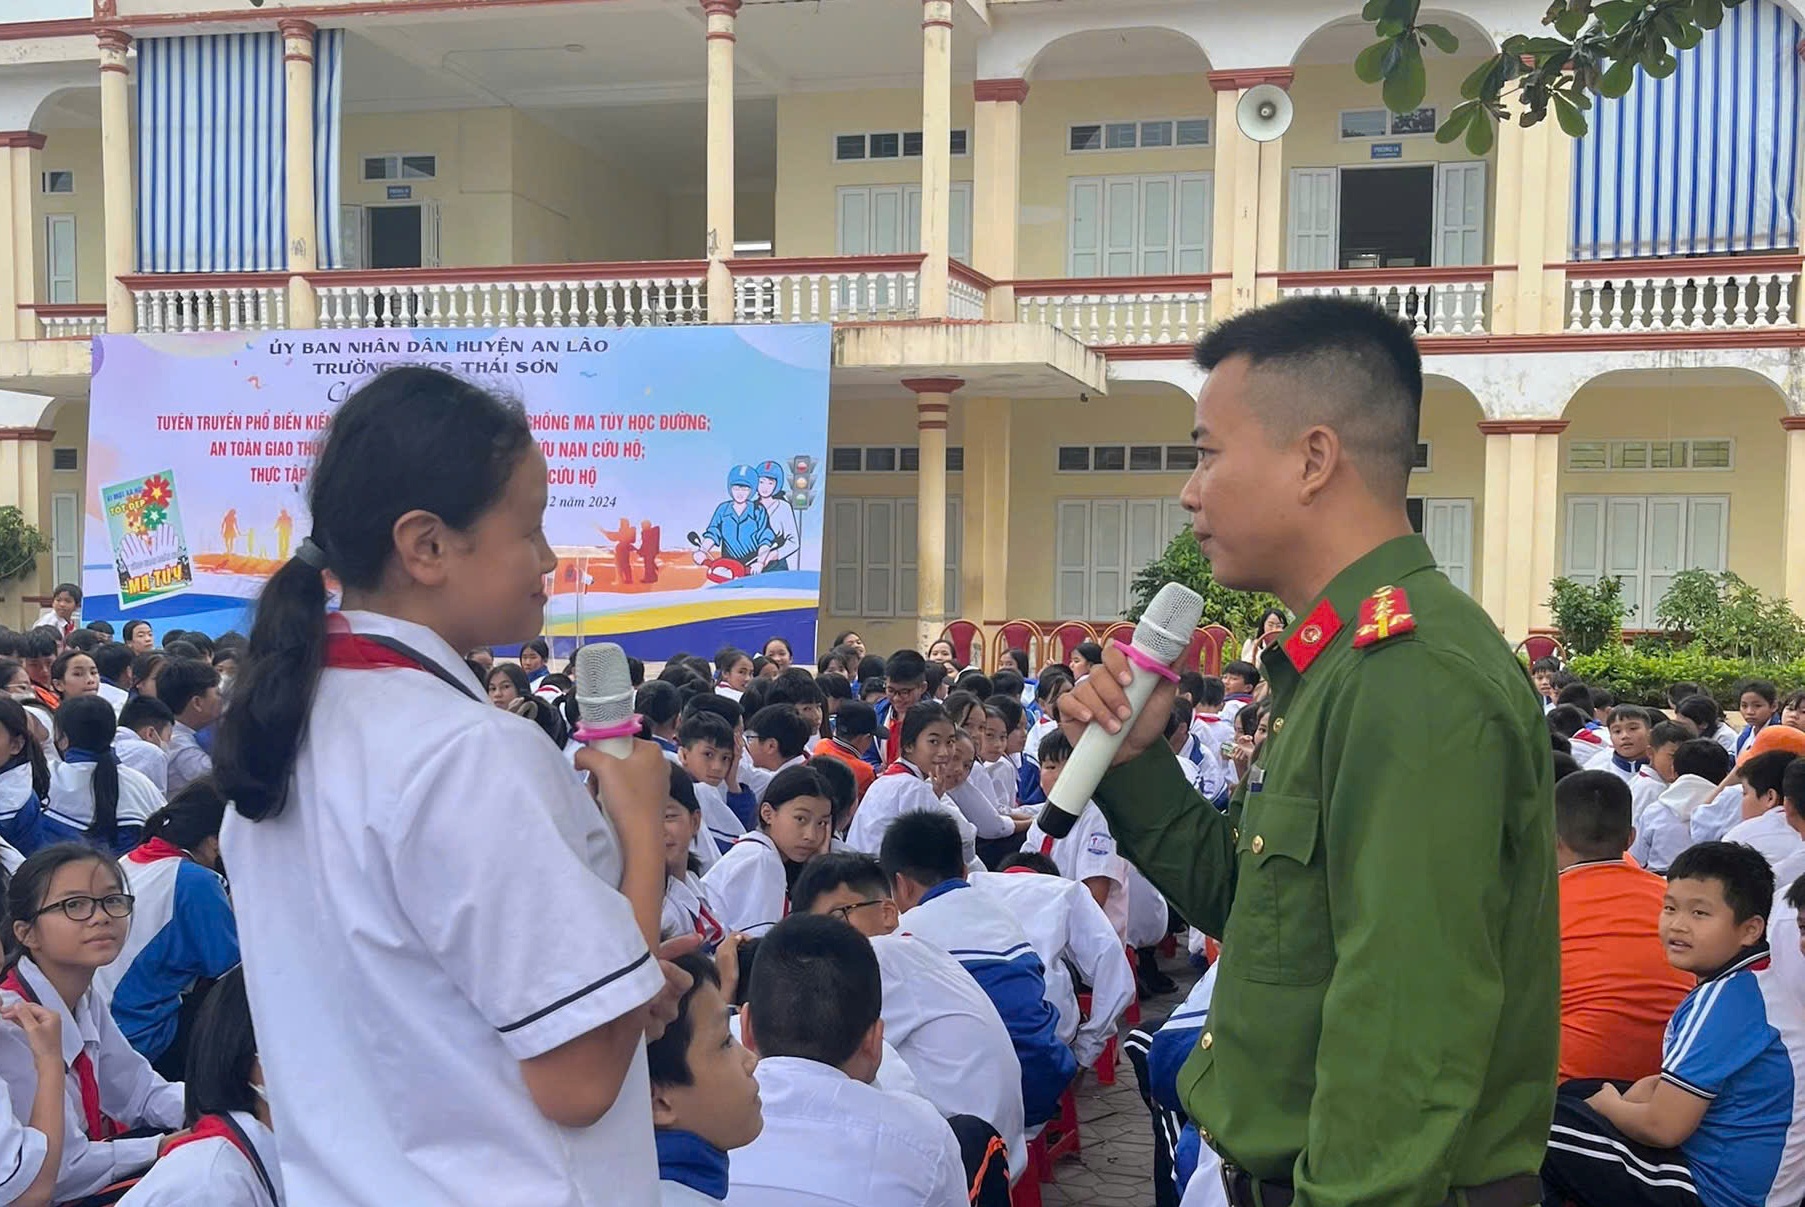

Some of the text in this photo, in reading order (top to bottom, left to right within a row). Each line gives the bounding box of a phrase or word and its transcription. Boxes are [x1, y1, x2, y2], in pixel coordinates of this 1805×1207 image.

[269, 337, 296, 355] ỦY
[302, 341, 341, 354] BAN
[347, 337, 400, 354] NHÂN
[407, 336, 448, 353] DÂN
[456, 336, 523, 356] HUYỆN
[531, 340, 560, 353] AN
[461, 357, 508, 373] THÁI
[516, 359, 558, 373] SƠN
[157, 412, 194, 431] TUYÊN
[197, 410, 242, 430] TRUYỀN
[274, 410, 301, 430] BIẾN
[574, 414, 596, 430] MA
[628, 414, 655, 434] HỌC
[210, 441, 227, 456] AN
[231, 438, 262, 456] TOÀN
[265, 441, 293, 456] GIAO
[559, 442, 588, 460] NẠN
[592, 438, 619, 458] CỨU
[250, 464, 597, 488] THỰC TẬP CỨU HỘ
[559, 495, 585, 508] năm
[588, 495, 617, 508] 2024
[127, 573, 151, 596] MA
